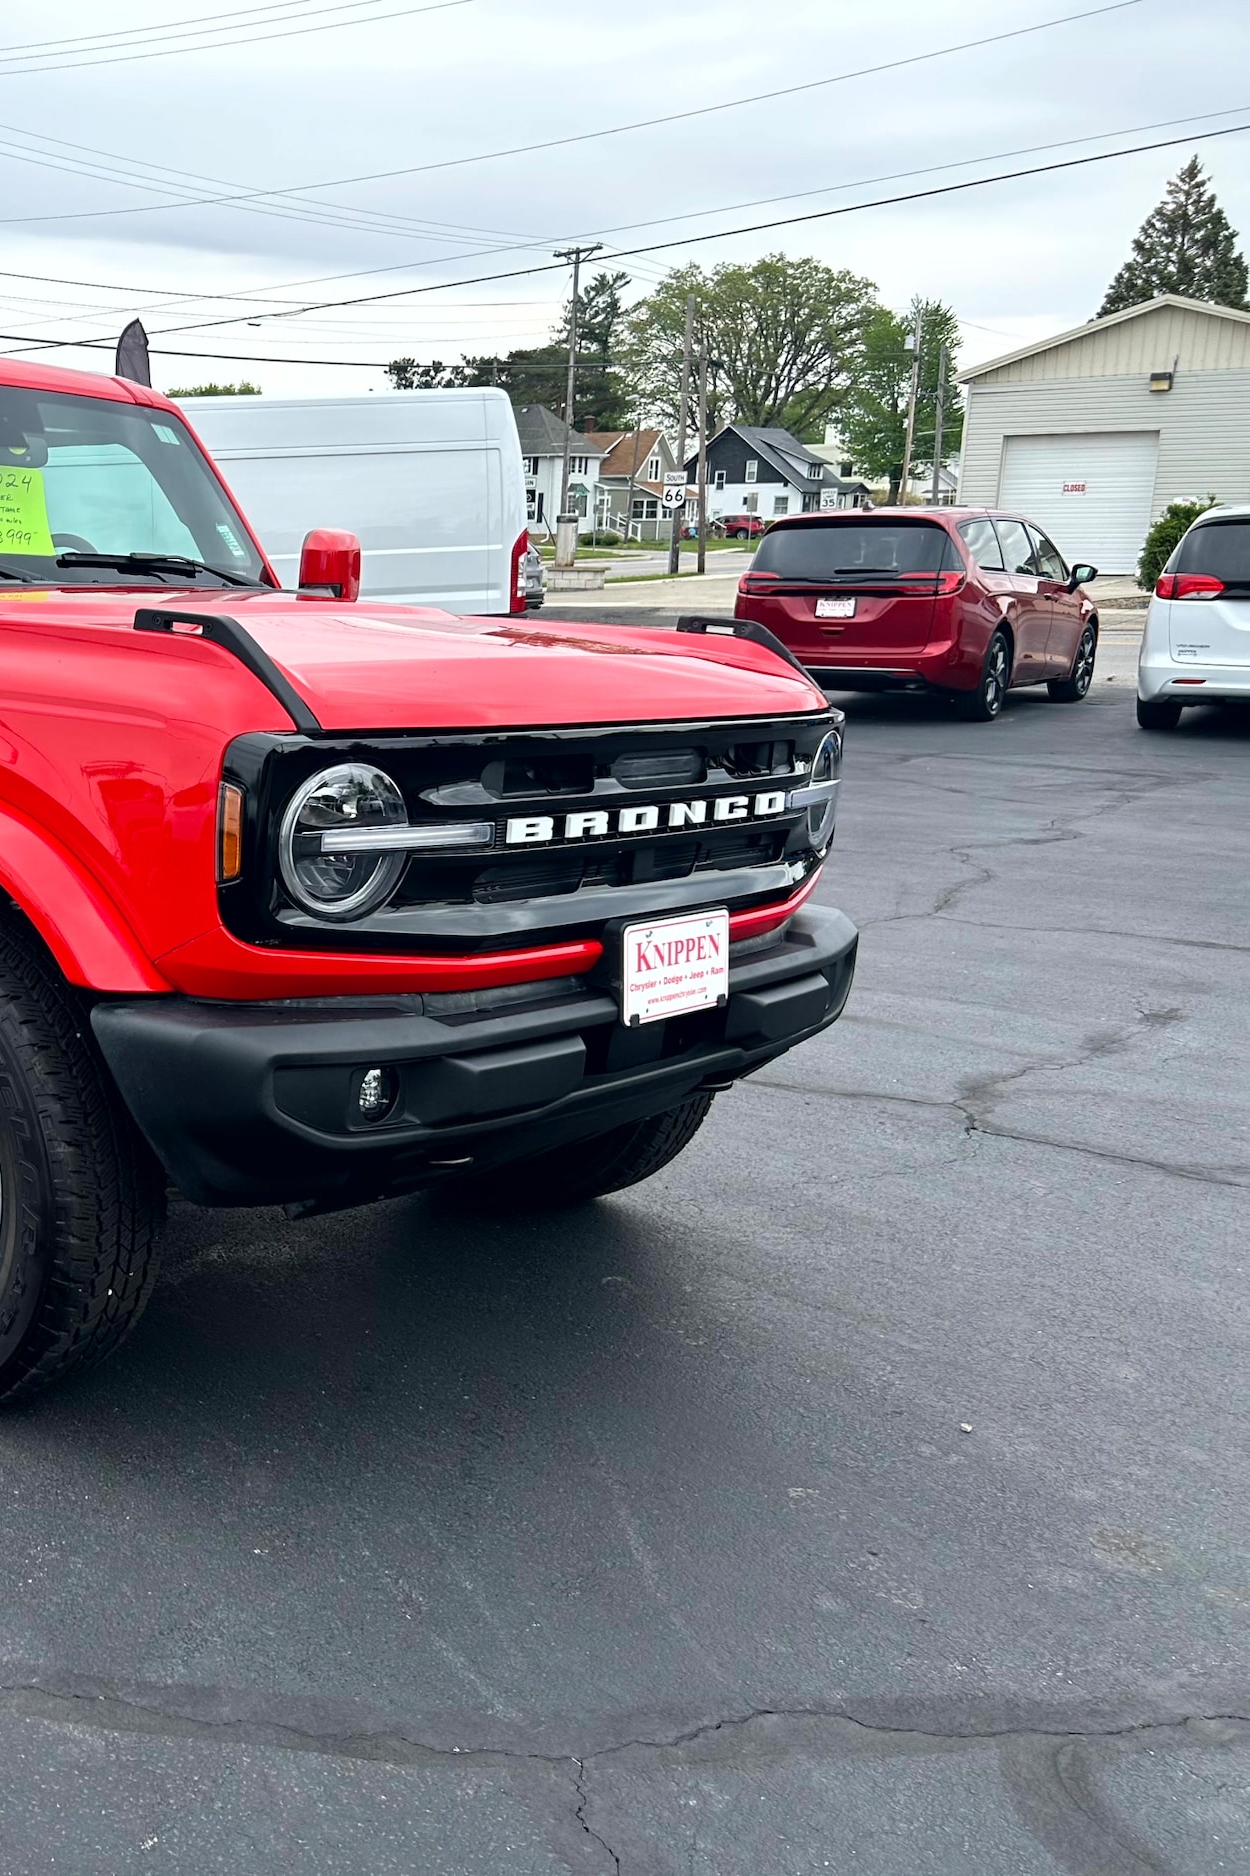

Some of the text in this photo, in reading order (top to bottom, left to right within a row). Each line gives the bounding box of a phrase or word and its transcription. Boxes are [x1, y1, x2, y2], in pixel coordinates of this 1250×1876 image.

[666, 473, 685, 481] SOUTH
[1062, 484, 1085, 492] CLOSED
[665, 489, 683, 502] 66
[822, 499, 835, 507] 35
[506, 791, 786, 844] BRONCO
[635, 933, 720, 973] KNIPPEN
[630, 967, 724, 992] Chrysler Dodge Jeep Ram
